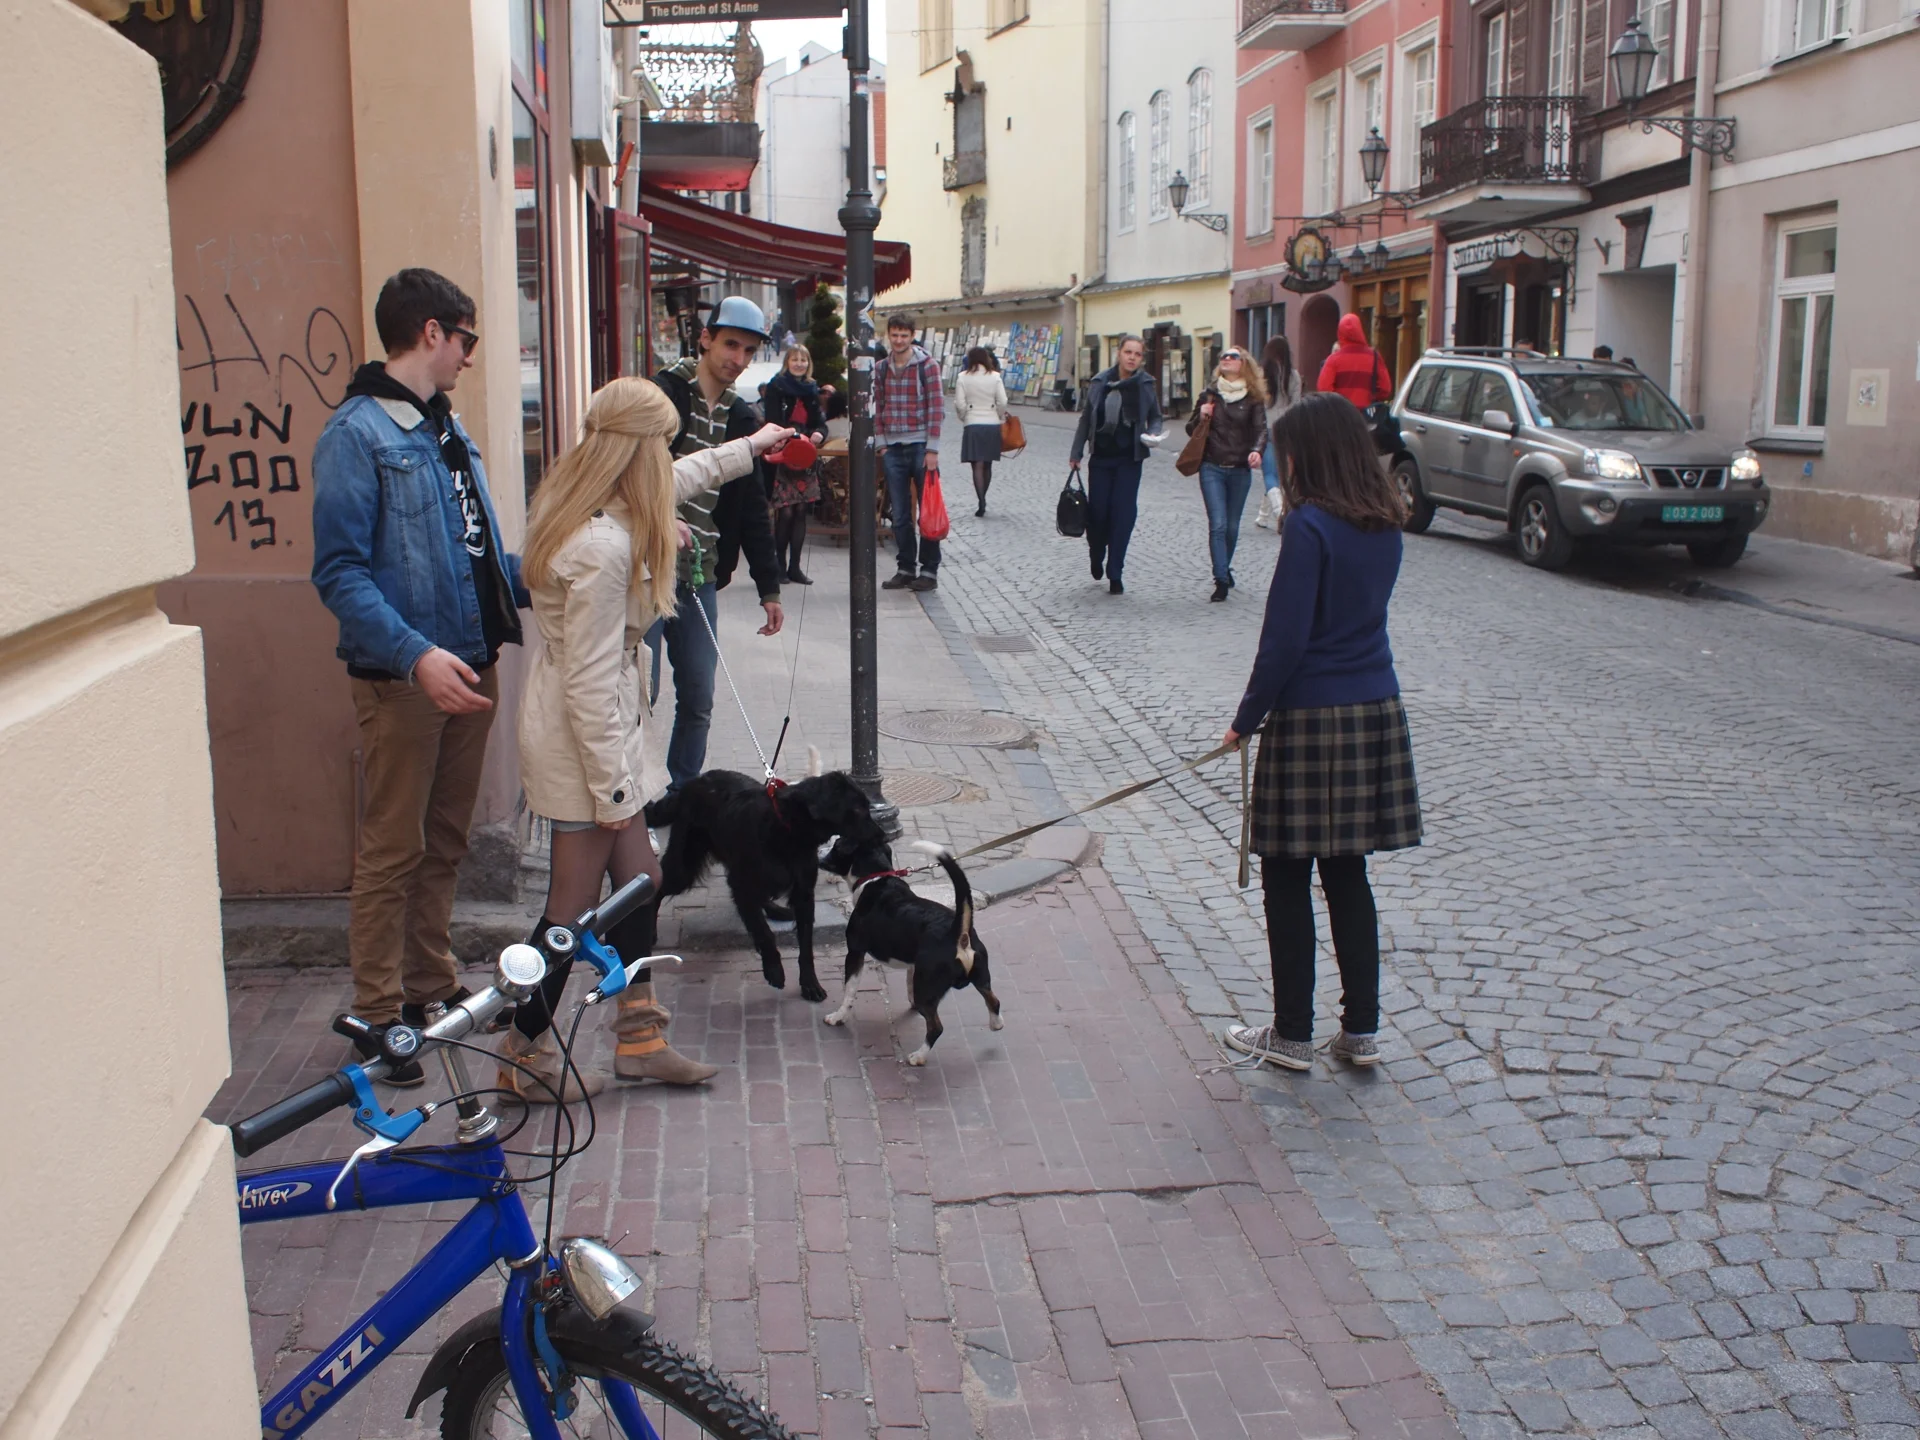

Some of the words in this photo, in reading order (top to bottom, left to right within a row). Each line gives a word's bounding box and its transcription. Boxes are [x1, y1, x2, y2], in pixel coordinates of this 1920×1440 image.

[651, 5, 670, 17] The
[671, 4, 707, 16] Church
[708, 3, 719, 15] of
[720, 2, 732, 14] St
[734, 2, 759, 13] Anne
